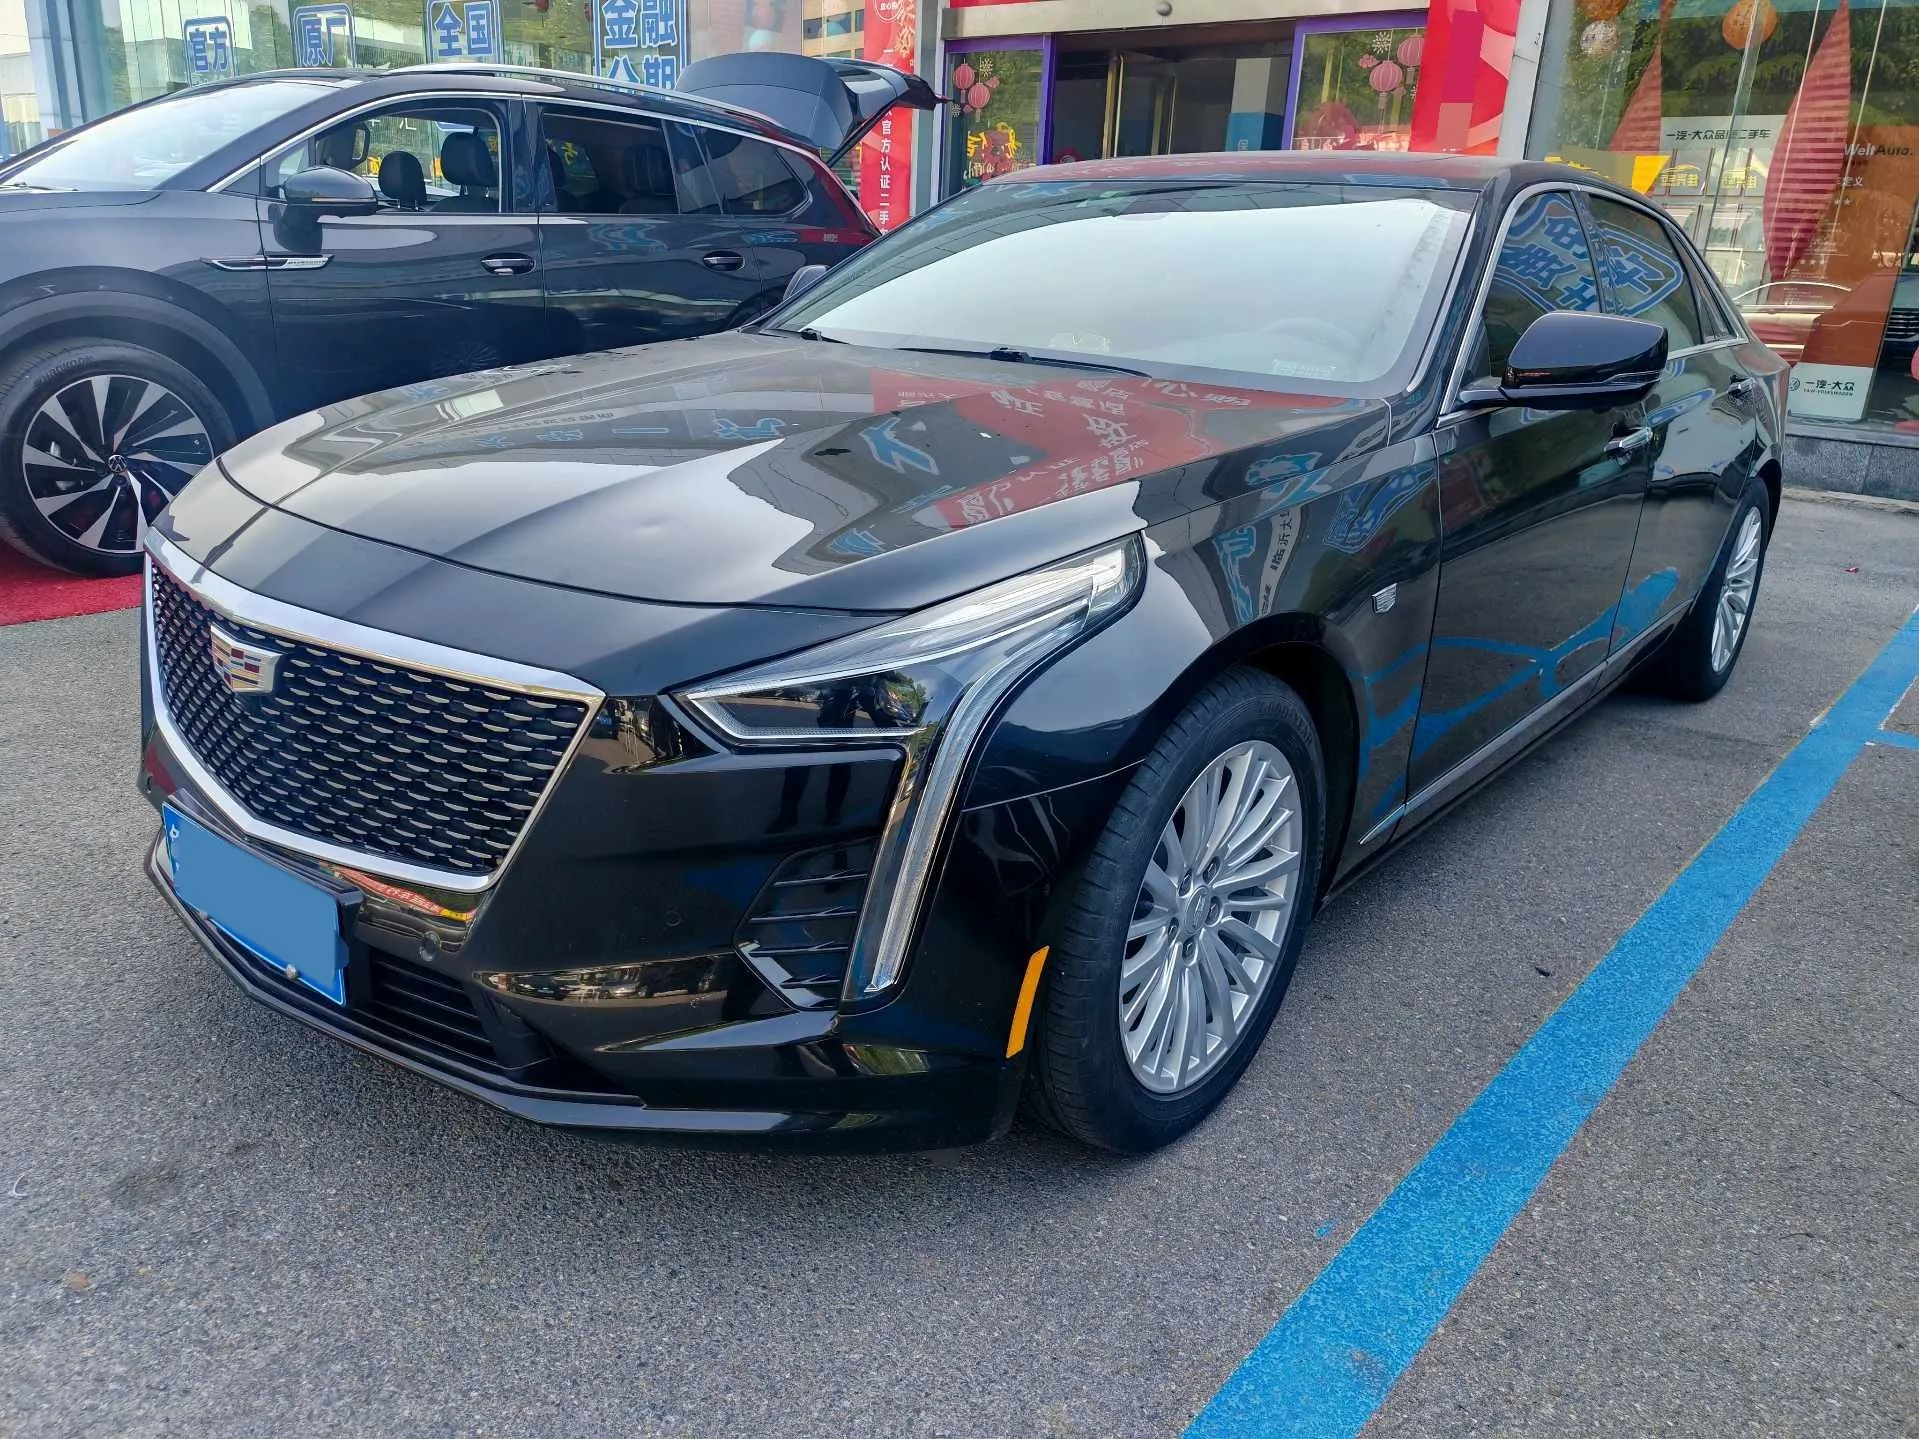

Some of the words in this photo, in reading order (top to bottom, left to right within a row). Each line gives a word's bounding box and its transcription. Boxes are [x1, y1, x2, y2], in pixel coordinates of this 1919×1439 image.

[189, 26, 228, 72] 官方
[301, 16, 347, 67] 原厂
[434, 1, 493, 57] 全国
[601, 0, 678, 49] 金融
